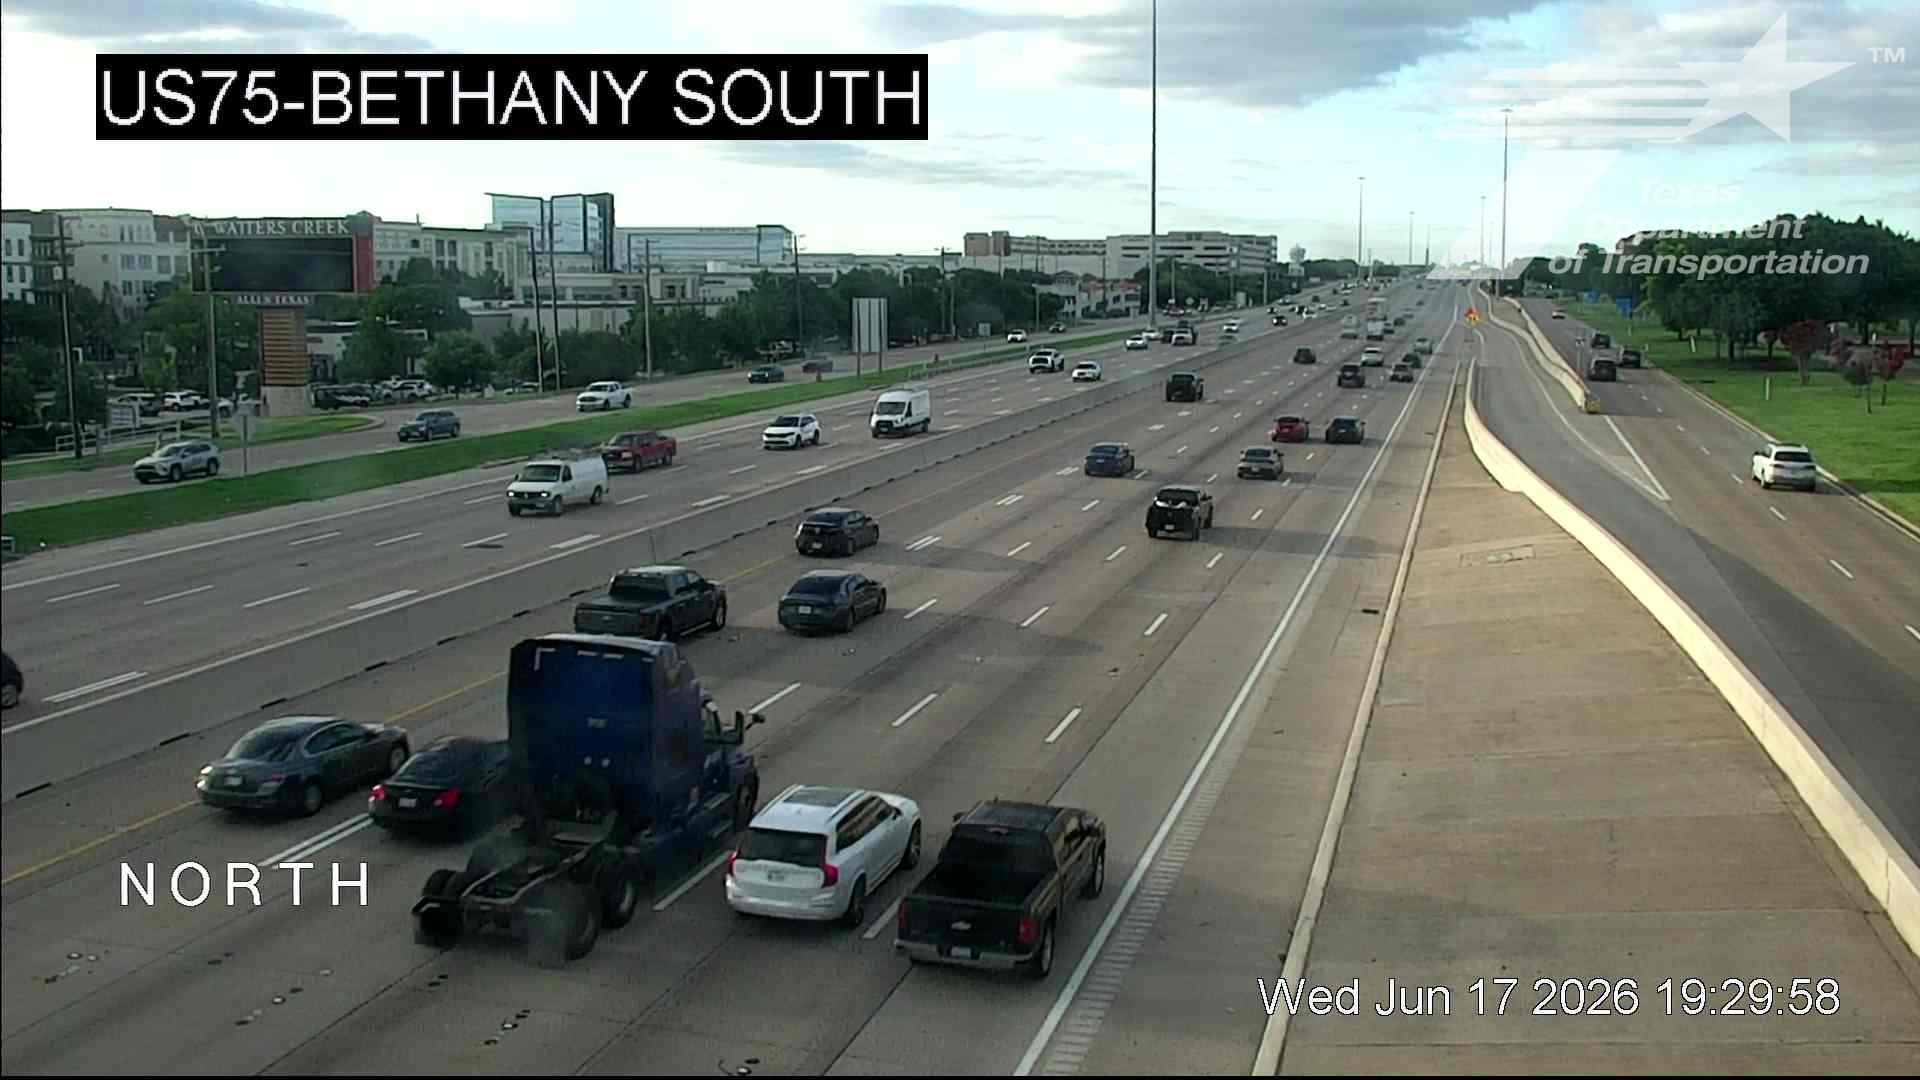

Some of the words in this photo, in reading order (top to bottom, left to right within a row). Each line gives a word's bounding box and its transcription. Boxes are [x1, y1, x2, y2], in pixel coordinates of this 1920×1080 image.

[213, 220, 286, 236] WATTERS
[292, 219, 350, 235] CREEK
[275, 295, 310, 305] TEXAS
